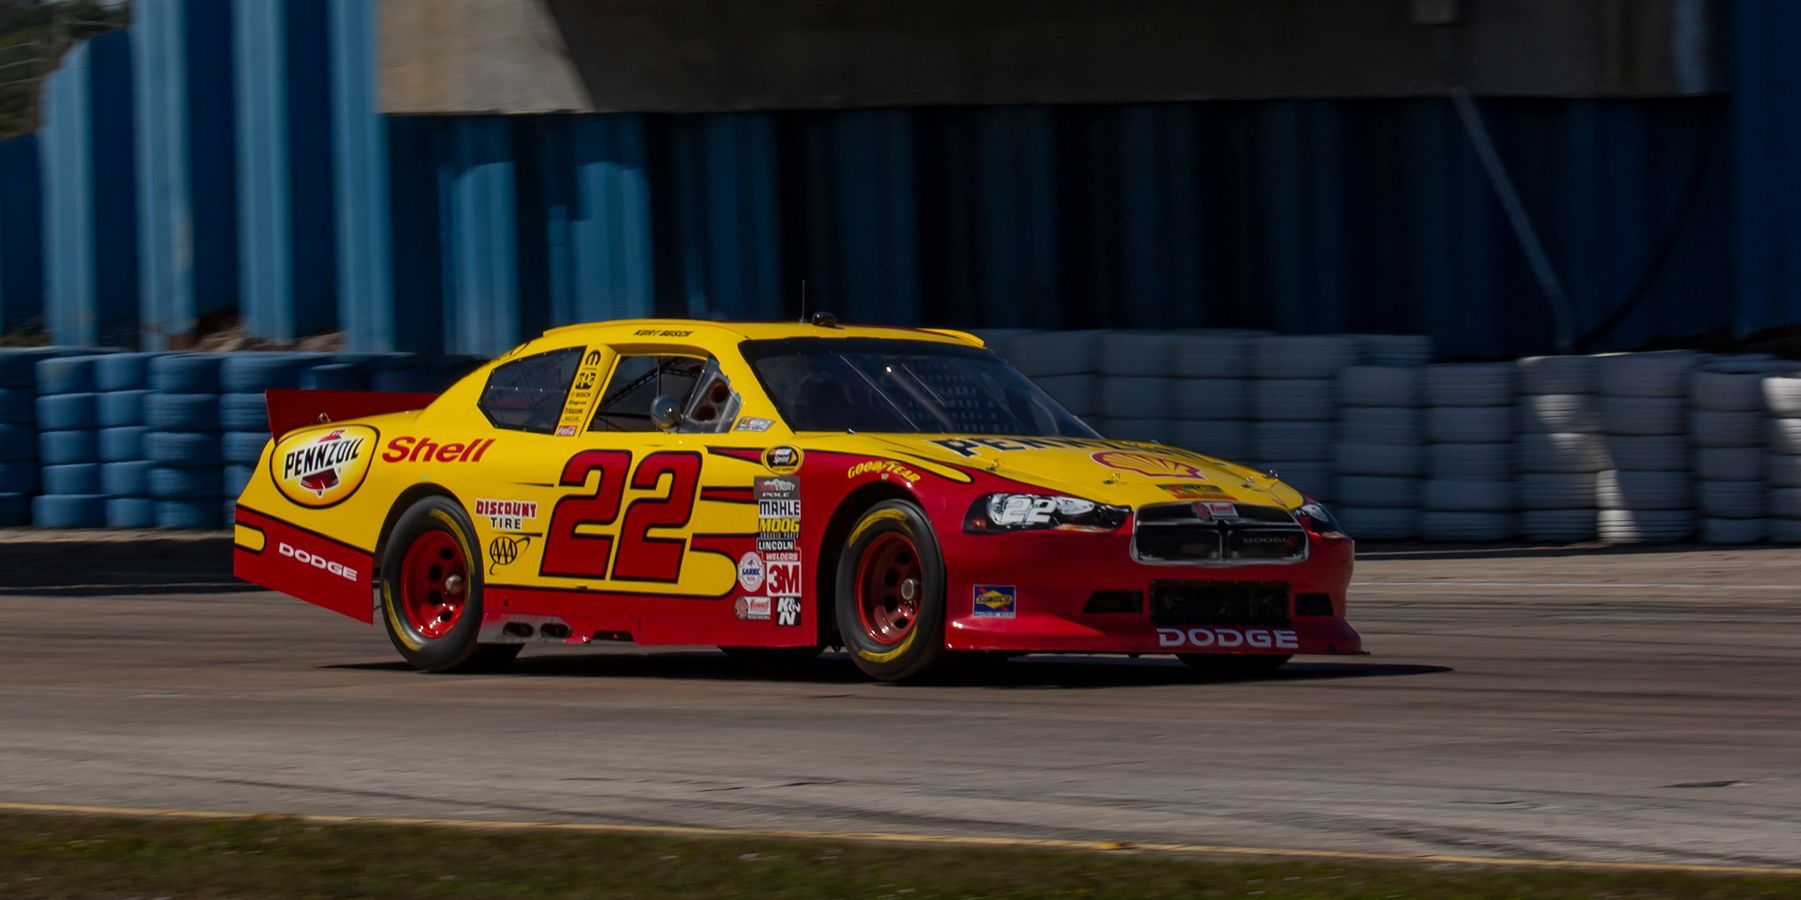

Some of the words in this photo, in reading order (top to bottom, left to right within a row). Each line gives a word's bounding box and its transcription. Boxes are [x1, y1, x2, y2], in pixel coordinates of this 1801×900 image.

[284, 438, 364, 480] PENNZOIL
[382, 436, 496, 463] Shell
[848, 461, 921, 483] GOODYEAR
[475, 499, 537, 518] DISCOUNT
[538, 449, 703, 584] 22
[759, 501, 800, 516] MAHLE
[1000, 496, 1057, 525] 22
[491, 517, 521, 530] TIRE
[759, 518, 800, 533] MOOG
[491, 536, 517, 565] AAA
[758, 541, 794, 551] LINCOLN
[766, 552, 798, 561] WELDERS
[278, 542, 358, 582] DODGE
[769, 564, 800, 594] 3M
[1159, 628, 1298, 649] DODGE
